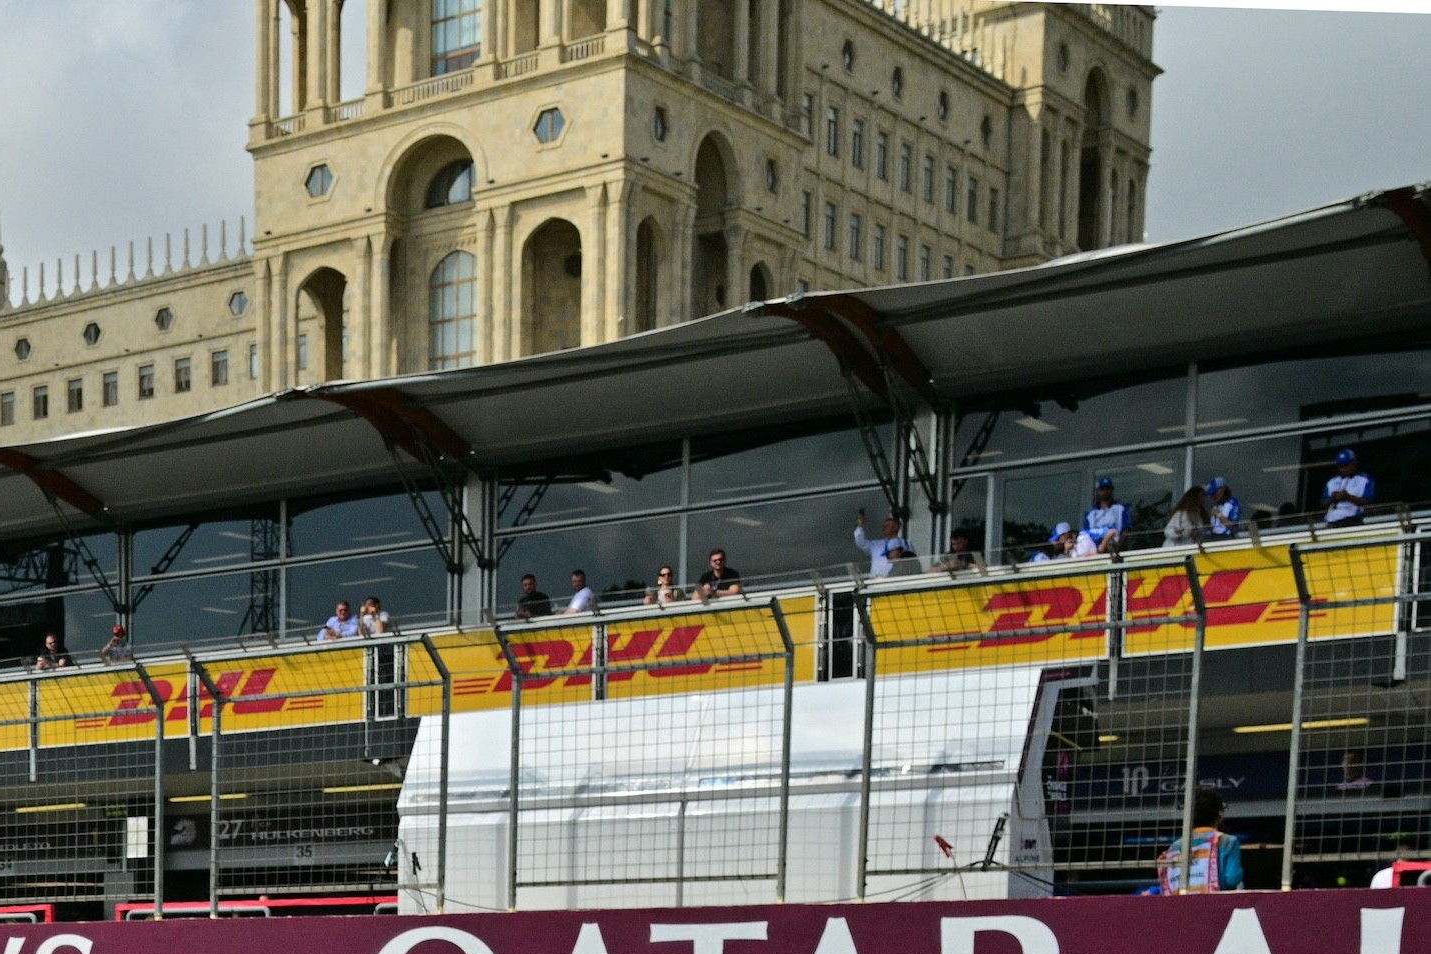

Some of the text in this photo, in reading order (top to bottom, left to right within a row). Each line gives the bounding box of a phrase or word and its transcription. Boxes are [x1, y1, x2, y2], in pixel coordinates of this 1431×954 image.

[977, 569, 1273, 649] DHL
[493, 623, 716, 693] DHL
[107, 667, 288, 726] DHL
[296, 845, 313, 859] 35
